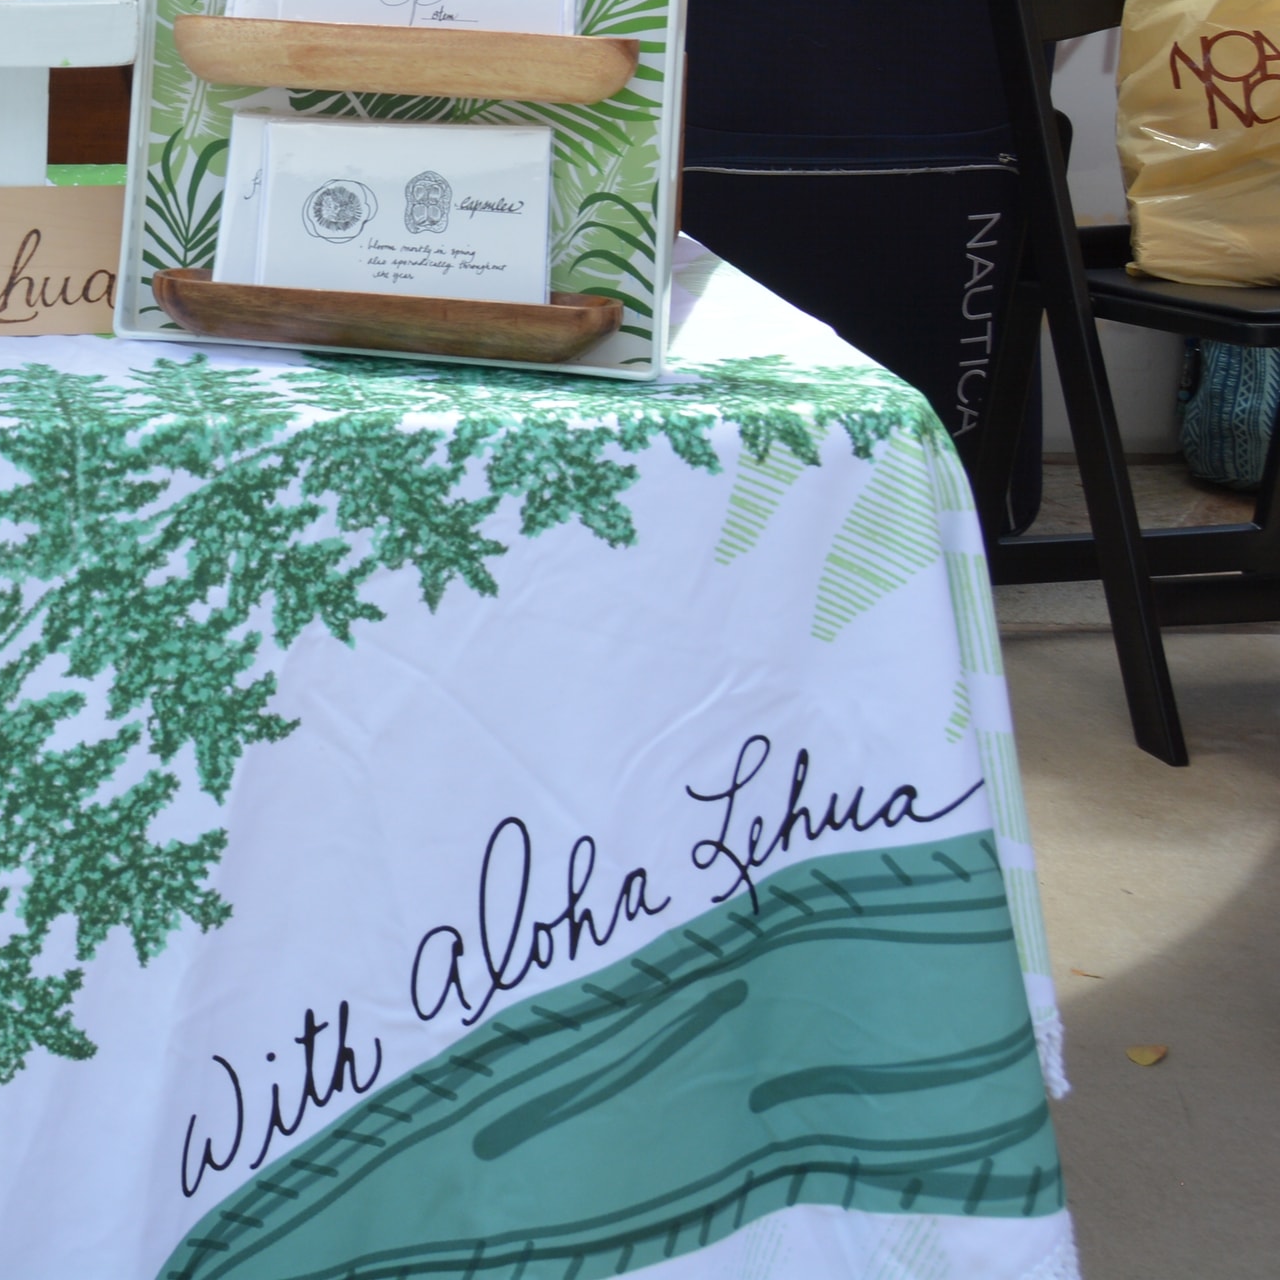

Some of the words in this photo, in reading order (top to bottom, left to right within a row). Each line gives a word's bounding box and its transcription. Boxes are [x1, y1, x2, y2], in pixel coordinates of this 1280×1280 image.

[1204, 72, 1280, 130] NO
[953, 211, 1002, 438] NAUTICA
[181, 999, 382, 1198] With
[684, 734, 986, 915] Lehua
